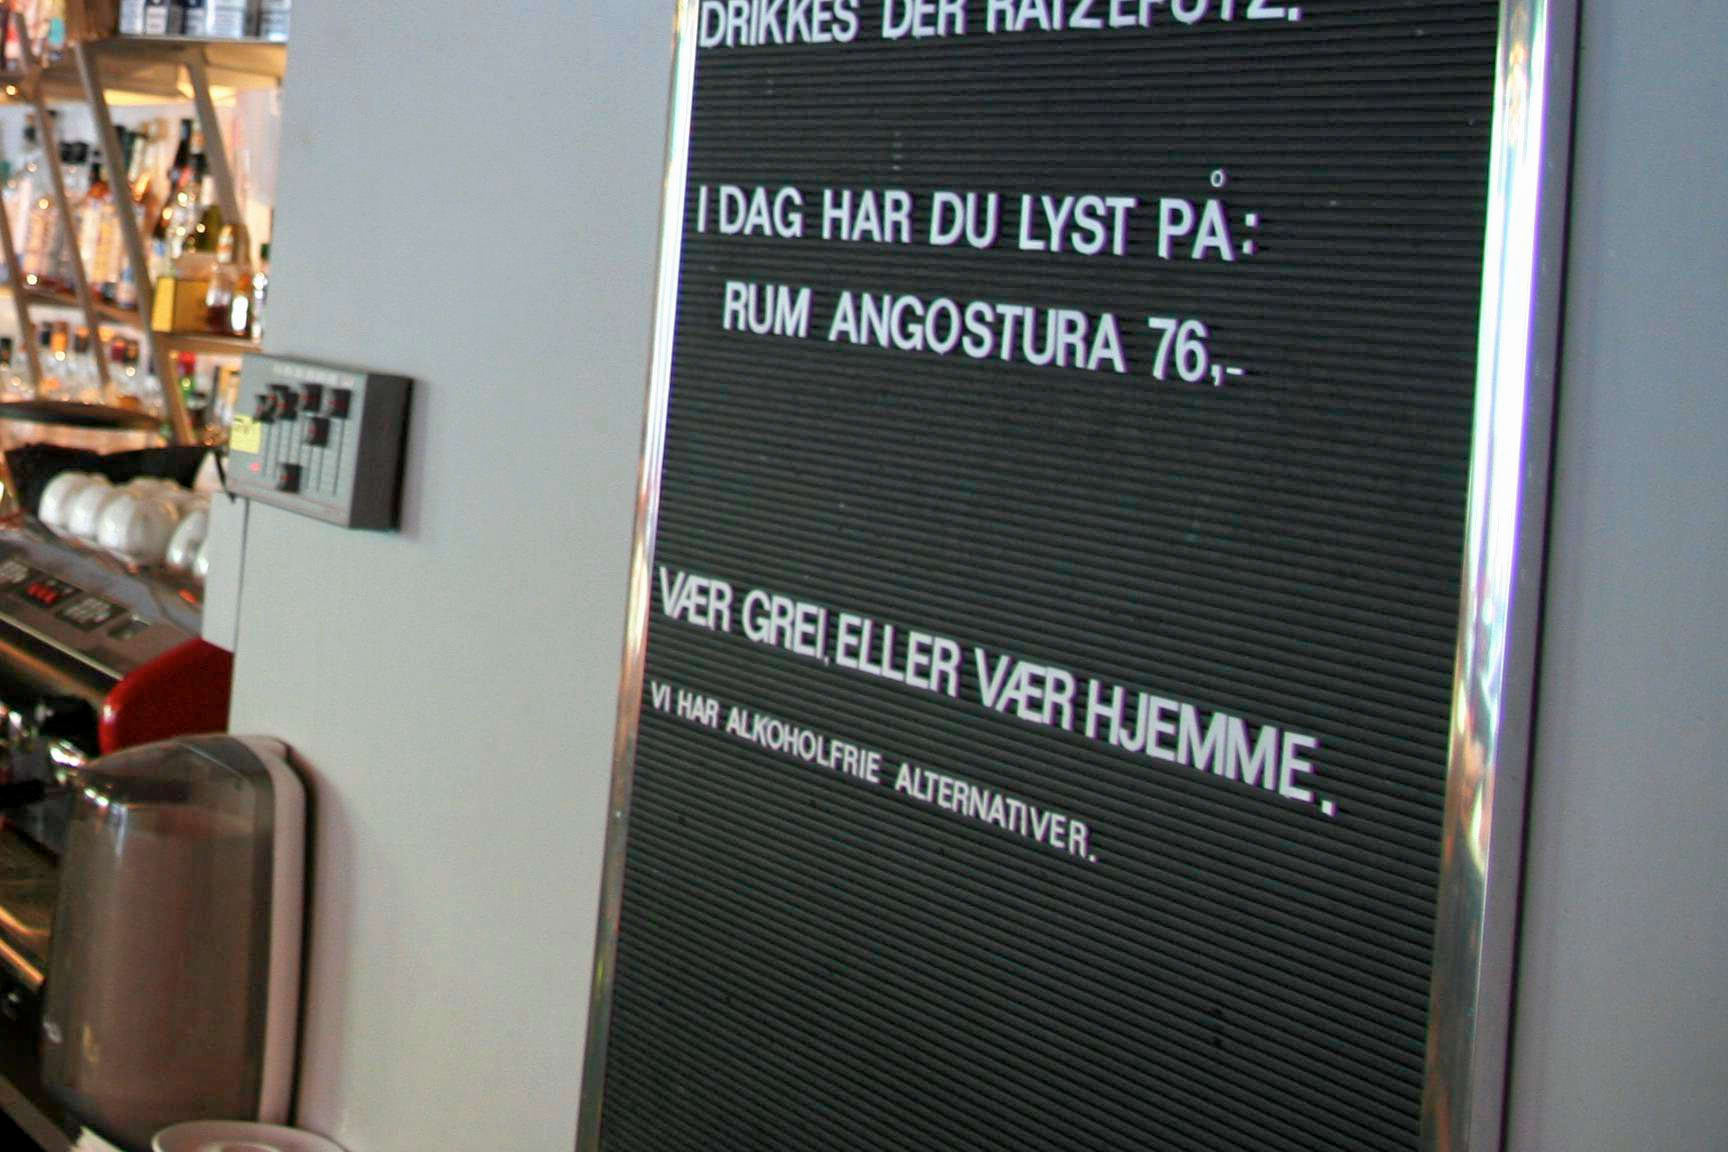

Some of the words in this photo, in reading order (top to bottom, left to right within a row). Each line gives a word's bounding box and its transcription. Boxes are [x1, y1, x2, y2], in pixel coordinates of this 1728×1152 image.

[695, 183, 710, 234] I
[717, 183, 805, 241] DAG
[820, 187, 913, 245] HAR
[927, 189, 1000, 250] DU
[1017, 192, 1139, 257] LYST
[721, 278, 814, 339] RUM
[826, 288, 1128, 374] ANGOSTURA
[1146, 315, 1245, 388] 76,-
[657, 563, 735, 634] VÆR
[973, 645, 1078, 732] VÆR
[1083, 677, 1336, 818] HJEMME.
[649, 679, 673, 714] VI
[675, 687, 722, 730] HAR
[724, 705, 884, 785] ALKOHOLFRIE
[893, 761, 1100, 864] ALTERNATIVER.
